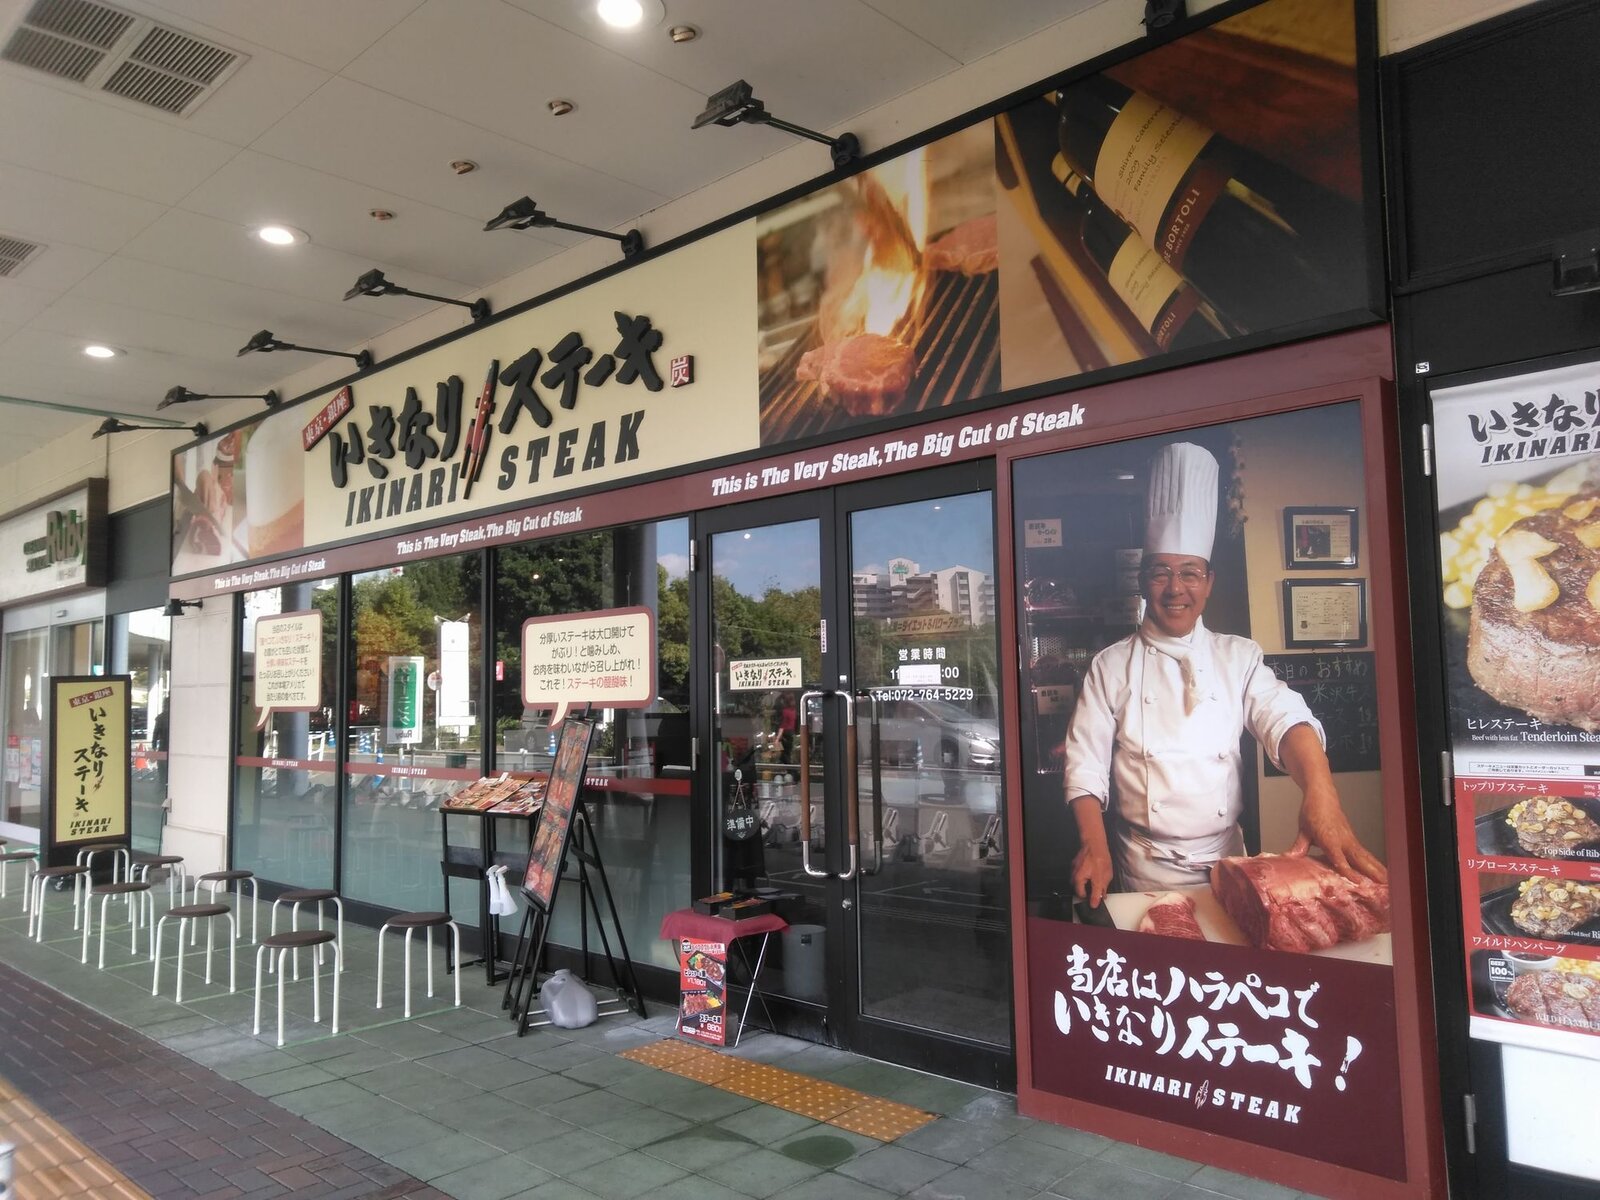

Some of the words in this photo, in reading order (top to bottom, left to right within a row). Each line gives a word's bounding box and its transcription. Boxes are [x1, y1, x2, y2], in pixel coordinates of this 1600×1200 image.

[1165, 189, 1200, 251] BORTOLI
[328, 375, 464, 489] いきなり
[498, 311, 664, 435] ステーキ
[712, 478, 743, 496] This
[744, 474, 758, 490] is
[761, 467, 790, 488] The
[794, 456, 829, 482] Very
[922, 432, 954, 459] Big
[958, 425, 992, 448] Cut
[995, 416, 1018, 441] of
[1021, 403, 1085, 437] Steak
[345, 462, 461, 527] IKINARI
[497, 410, 645, 491] STEAK
[397, 540, 415, 555] This
[414, 538, 423, 552] is
[423, 535, 439, 550] The
[440, 532, 459, 548] Very
[504, 519, 521, 537] Big
[522, 515, 540, 532] Cut
[540, 511, 552, 528] of
[552, 506, 583, 526] Steak
[231, 575, 241, 587] The
[241, 573, 254, 585] Very
[281, 565, 291, 579] Big
[291, 563, 301, 575] Cut
[301, 561, 309, 573] of
[307, 558, 326, 572] Steak
[898, 647, 946, 661] 営業時間
[1316, 656, 1368, 678] おすすめ
[1467, 718, 1542, 730] ヒレステーキ
[89, 707, 108, 777] いきなり
[1520, 731, 1577, 742] Tenderloin
[74, 748, 91, 812] ステーキ
[586, 778, 608, 787] STEAK
[1463, 781, 1549, 794] トップリブステーキ
[70, 817, 112, 829] IKINARI
[70, 825, 108, 836] STEAK
[727, 815, 754, 831] 準備中
[1543, 847, 1558, 857] Top
[1558, 847, 1575, 856] Side
[1576, 849, 1585, 857] of
[1467, 859, 1561, 875] リブロースステーキ
[1472, 936, 1567, 954] ワイルドハンバーグ
[1066, 944, 1320, 1028] 当店はハラペコで
[1105, 1065, 1192, 1099] IKINARI
[1211, 1088, 1301, 1124] STEAK
